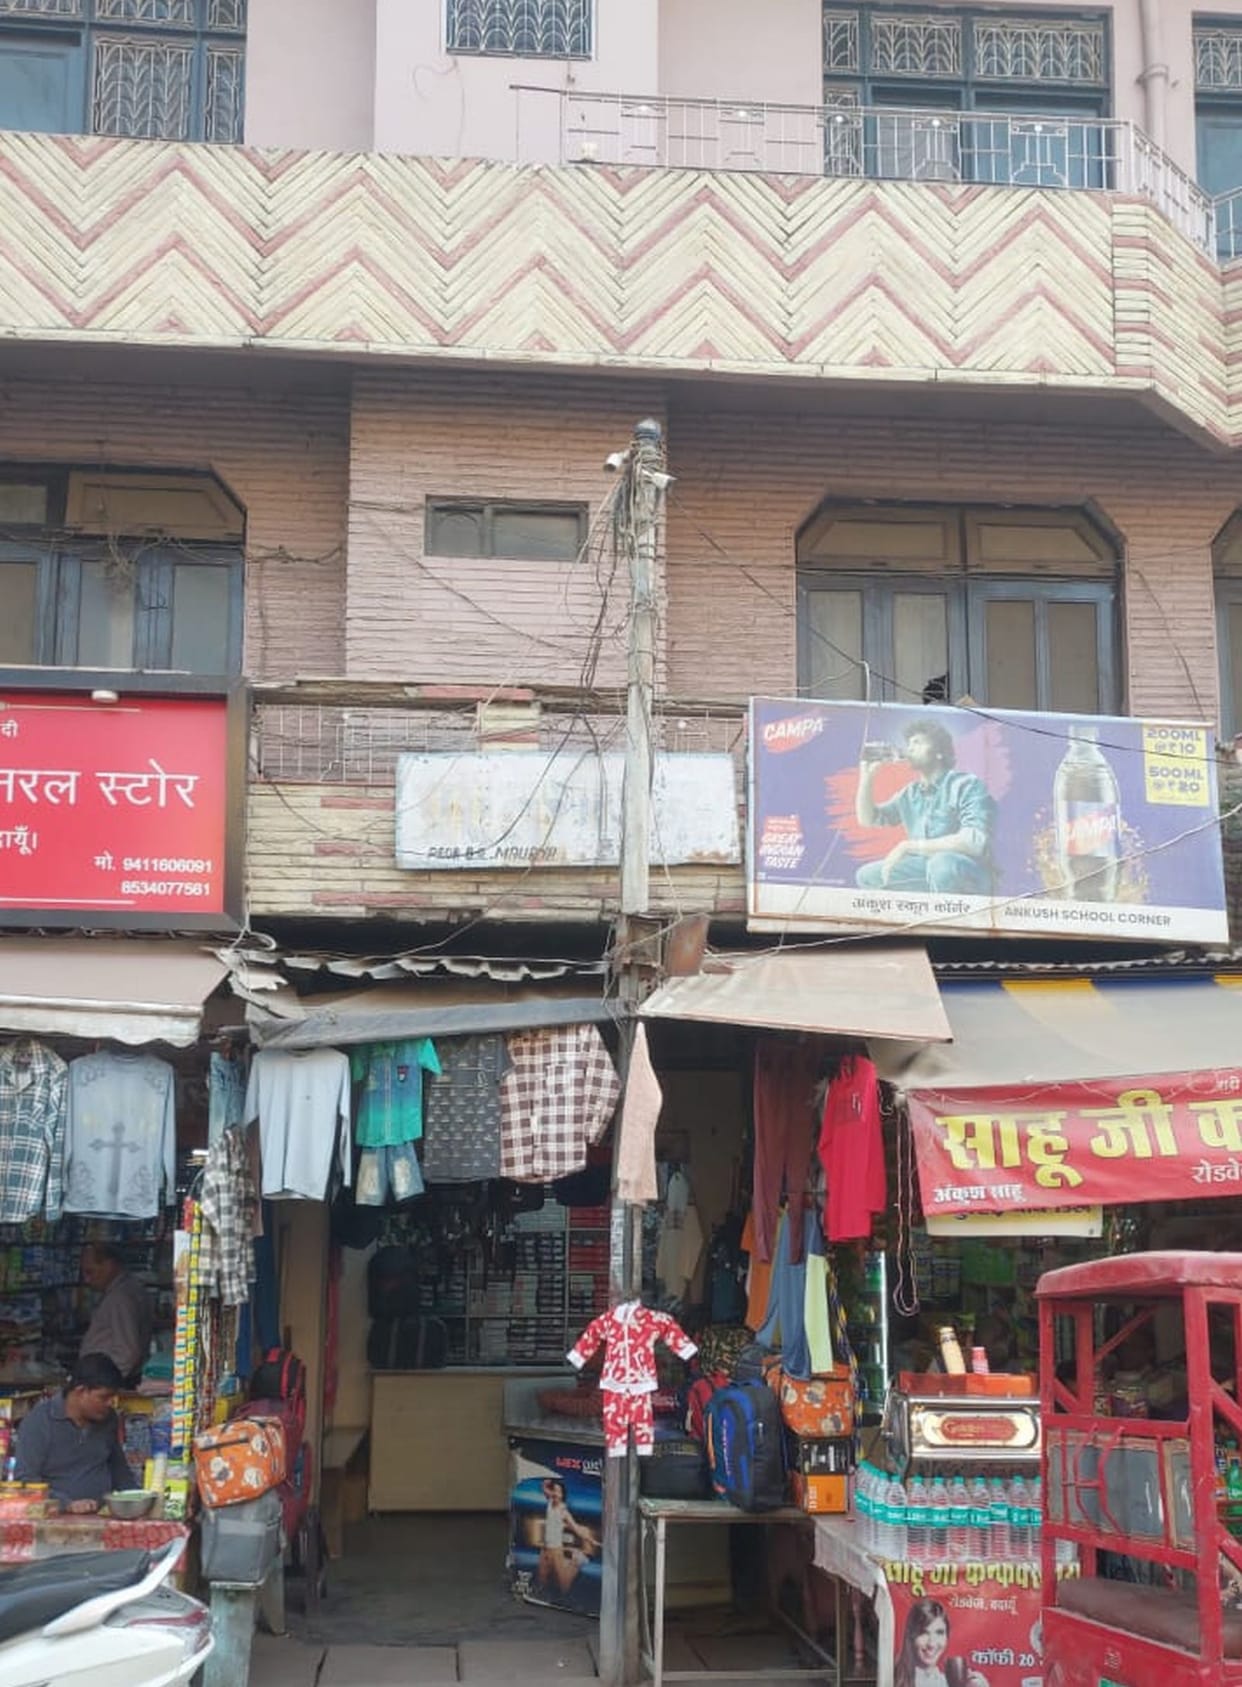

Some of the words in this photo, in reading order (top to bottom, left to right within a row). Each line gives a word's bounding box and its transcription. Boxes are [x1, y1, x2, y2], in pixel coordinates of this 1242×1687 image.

[763, 717, 824, 741] CAMPA
[95, 757, 200, 808] स्टोर
[1005, 906, 1058, 920] ANKUSH
[1062, 909, 1114, 923] SCHOOL
[1118, 912, 1172, 926] CORNER
[936, 1110, 1083, 1188] साहू
[1080, 1089, 1178, 1159] जी
[1191, 1157, 1242, 1184] रोडवे
[971, 1647, 1014, 1666] कॉफी
[1019, 1653, 1035, 1668] 20
